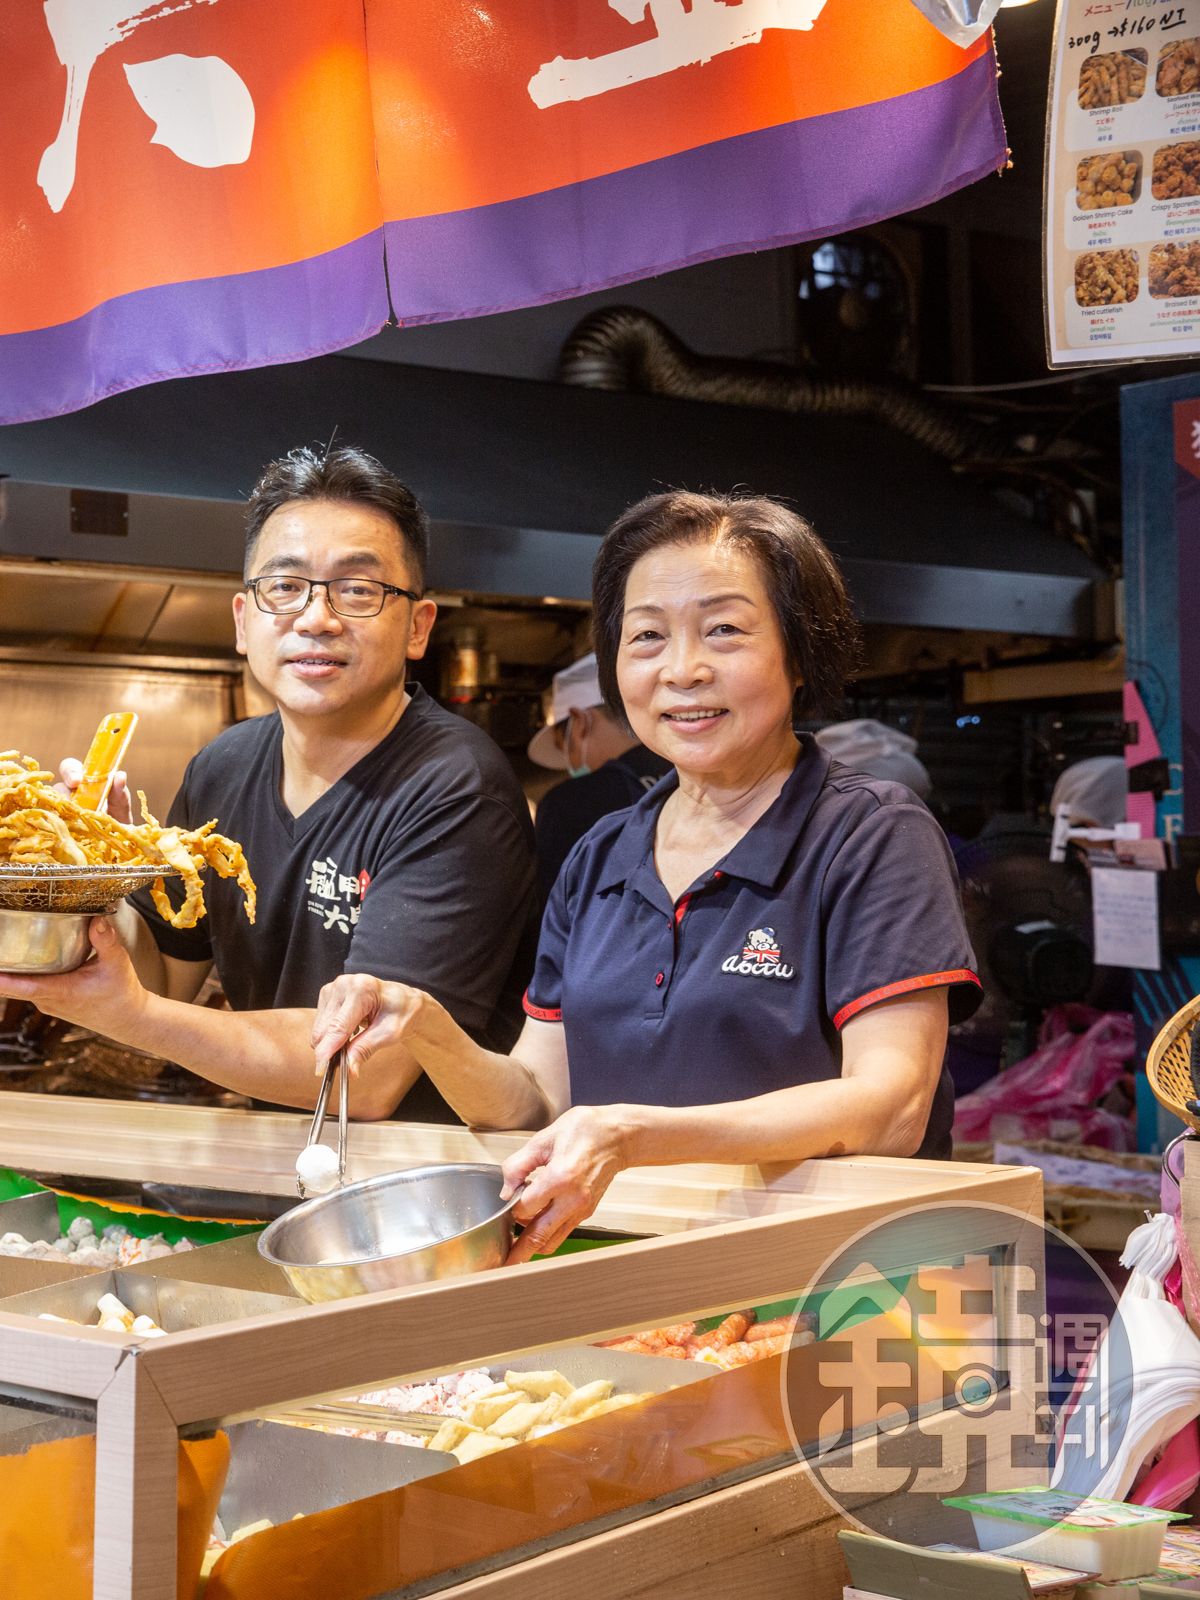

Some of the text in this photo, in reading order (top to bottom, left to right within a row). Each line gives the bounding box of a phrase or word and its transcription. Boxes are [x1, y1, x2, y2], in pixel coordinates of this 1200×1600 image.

[1068, 31, 1100, 54] 300g
[1094, 209, 1117, 218] Shrimp
[1117, 208, 1133, 216] Cake
